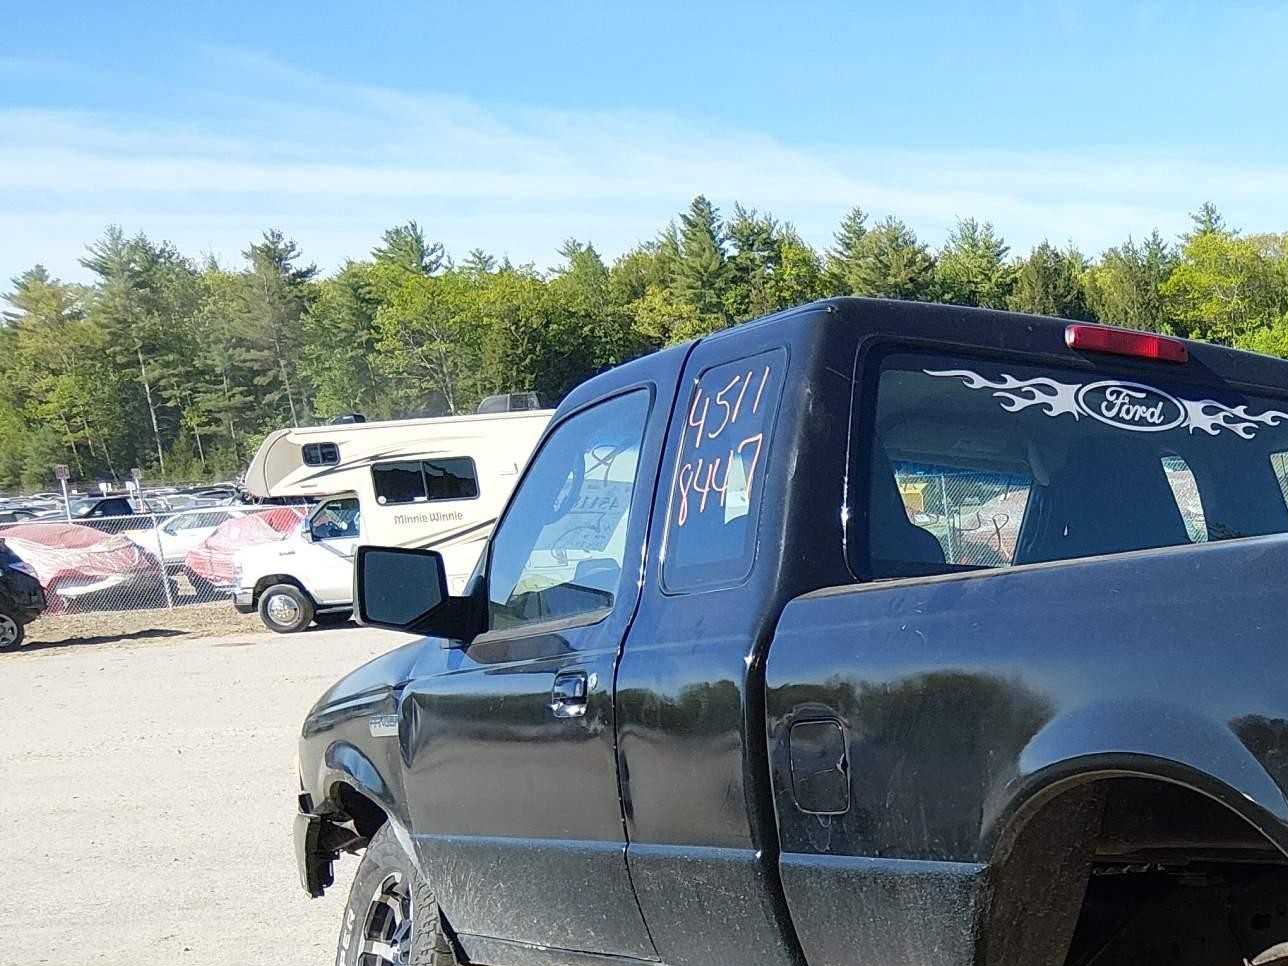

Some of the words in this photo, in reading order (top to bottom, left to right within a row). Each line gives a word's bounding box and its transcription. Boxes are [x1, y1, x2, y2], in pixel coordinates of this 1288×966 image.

[689, 366, 770, 449] 4511
[1101, 386, 1165, 424] Ford
[679, 432, 763, 527] 8447
[394, 513, 428, 525] Minnie
[429, 511, 463, 522] Winnie
